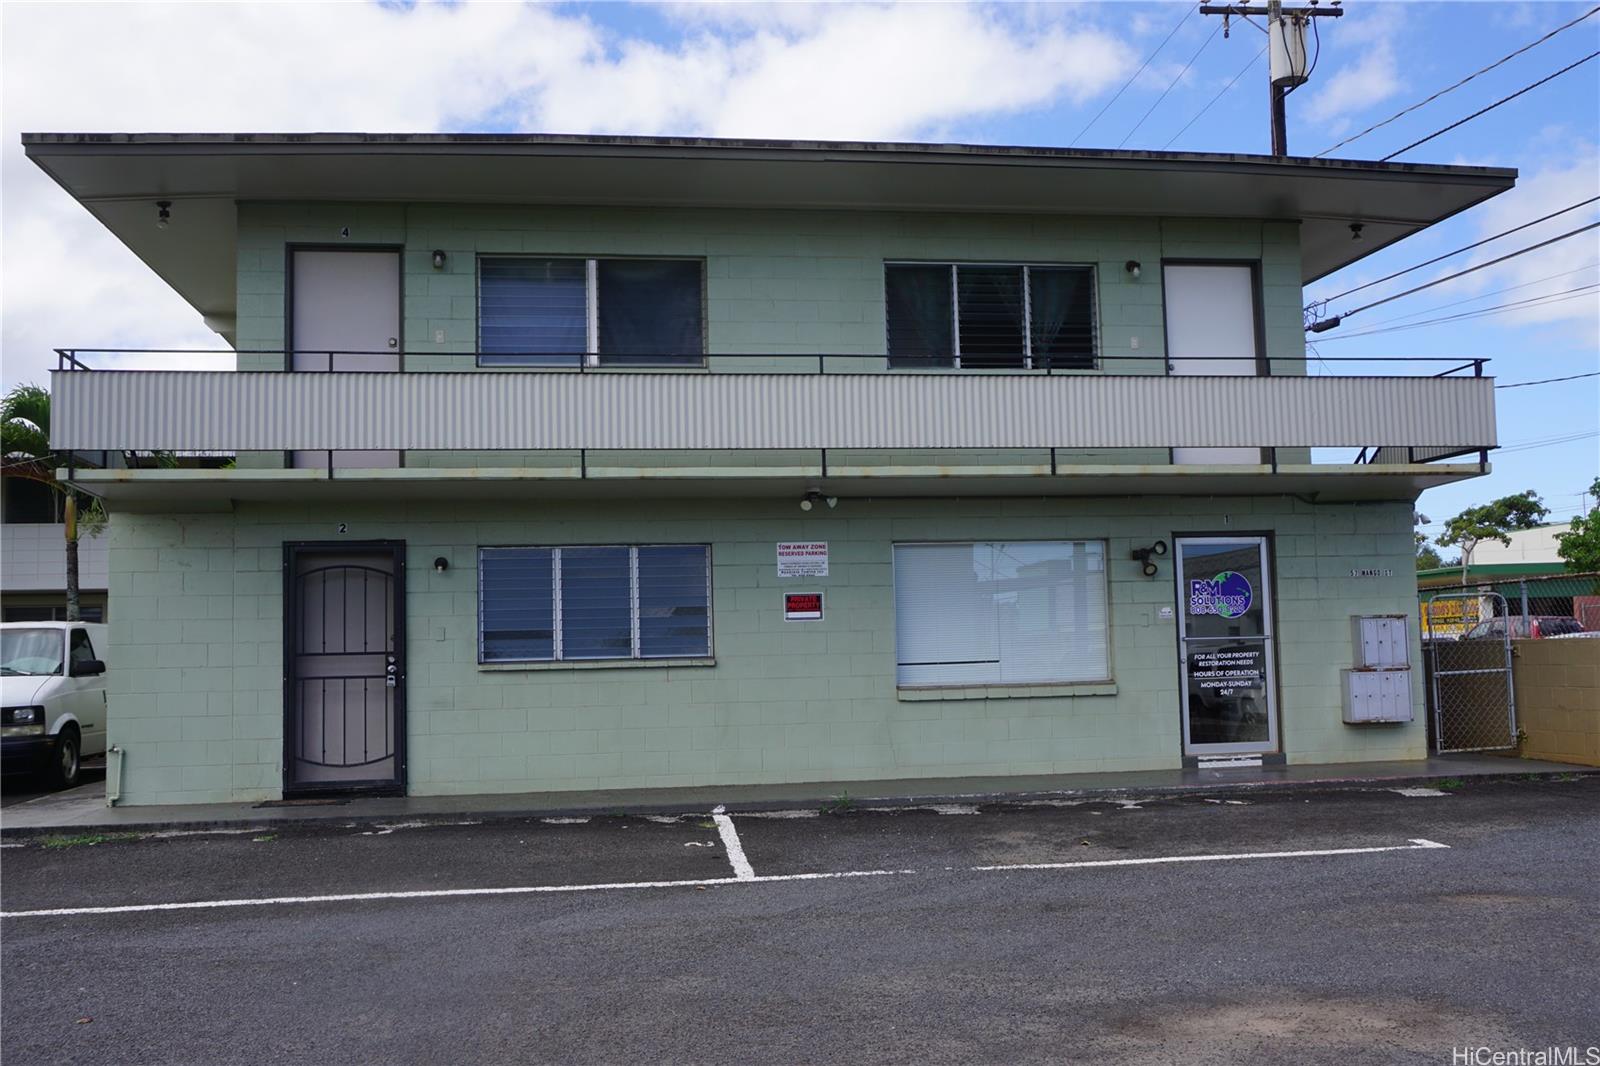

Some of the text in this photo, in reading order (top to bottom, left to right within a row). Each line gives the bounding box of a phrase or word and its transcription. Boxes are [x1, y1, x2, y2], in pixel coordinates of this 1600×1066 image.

[341, 227, 349, 238] 4
[339, 523, 347, 534] 2
[1191, 579, 1221, 596] R&M
[1190, 595, 1246, 606] SOLUTIONS
[1200, 680, 1252, 688] MONDAY-SUNDAY
